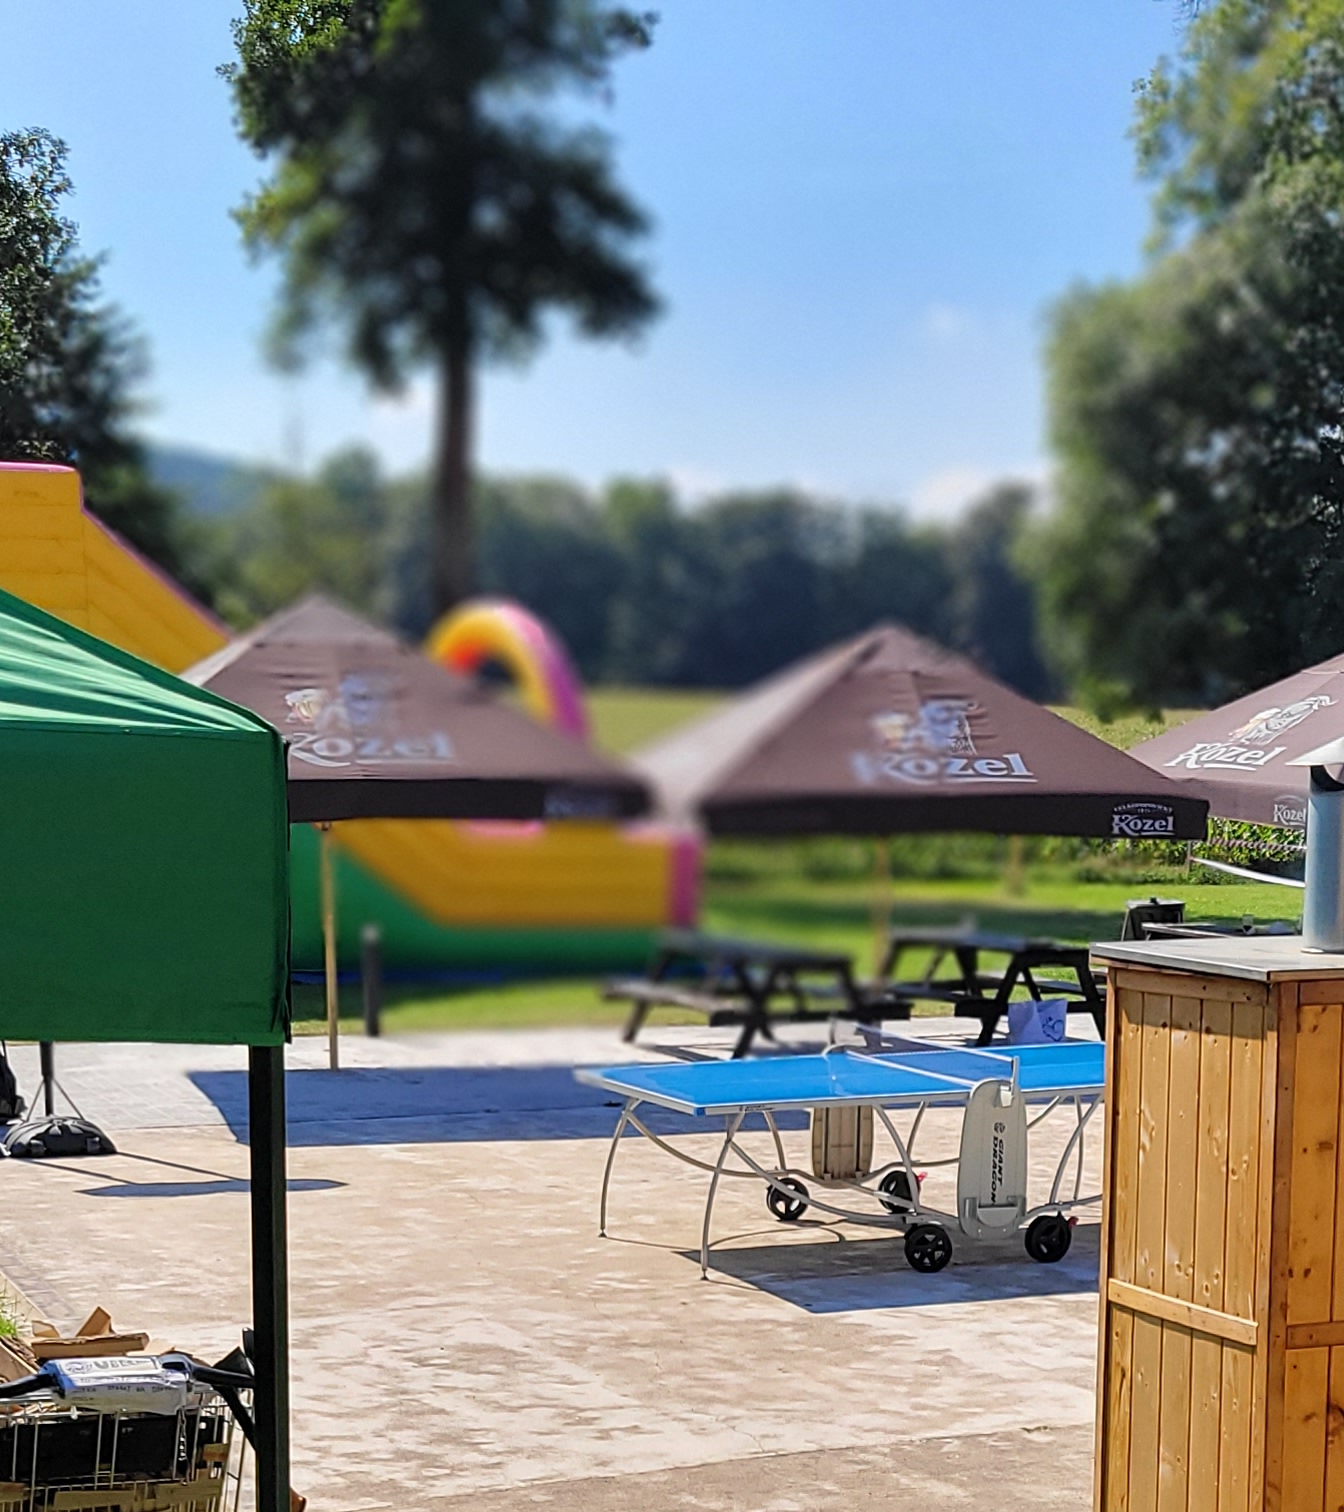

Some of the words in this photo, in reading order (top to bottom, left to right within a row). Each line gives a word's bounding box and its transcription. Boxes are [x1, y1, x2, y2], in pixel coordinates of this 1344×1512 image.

[1162, 742, 1288, 771] Kozel
[1112, 814, 1175, 837] Kozel
[1272, 804, 1307, 826] Kozel
[990, 1135, 999, 1204] DRAGON
[996, 1138, 1005, 1187] GIANT
